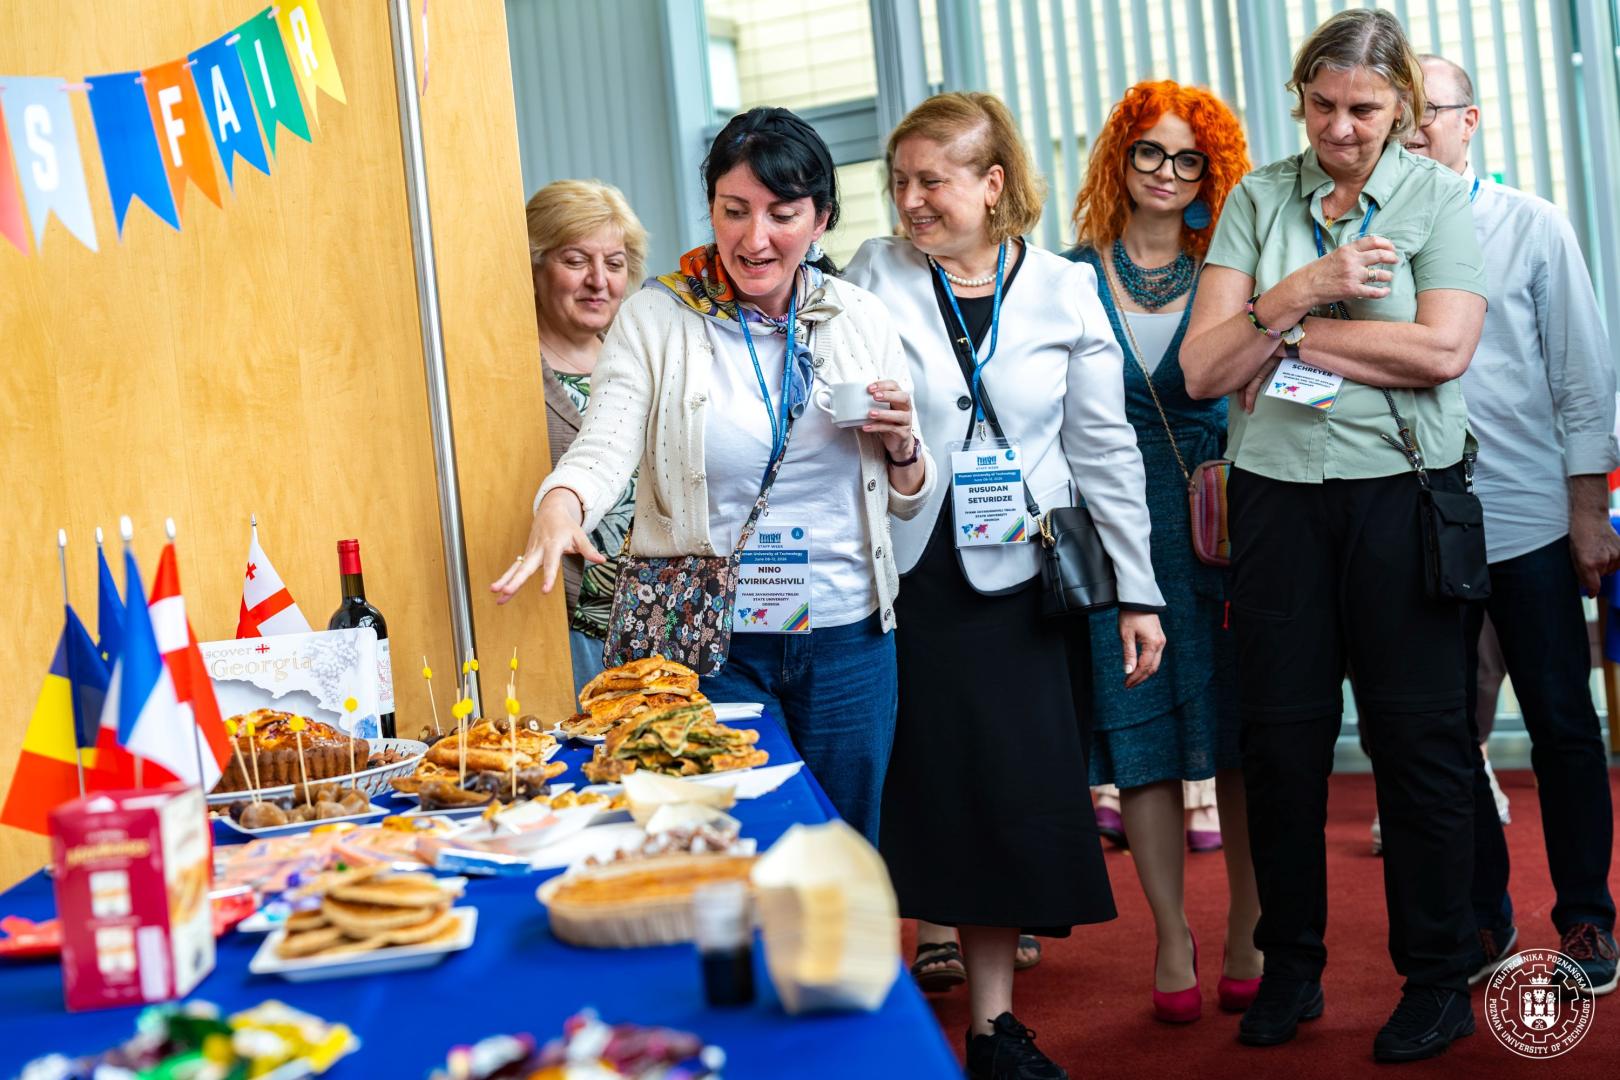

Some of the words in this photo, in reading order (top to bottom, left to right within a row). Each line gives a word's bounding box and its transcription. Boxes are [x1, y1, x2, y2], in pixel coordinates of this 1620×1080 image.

[157, 5, 319, 169] FAIR
[1292, 364, 1333, 377] SCHREYER
[969, 485, 1008, 493] RUSUDAN
[968, 495, 1013, 504] SETURIDZE
[205, 647, 253, 658] scover
[210, 651, 313, 682] Georgia
